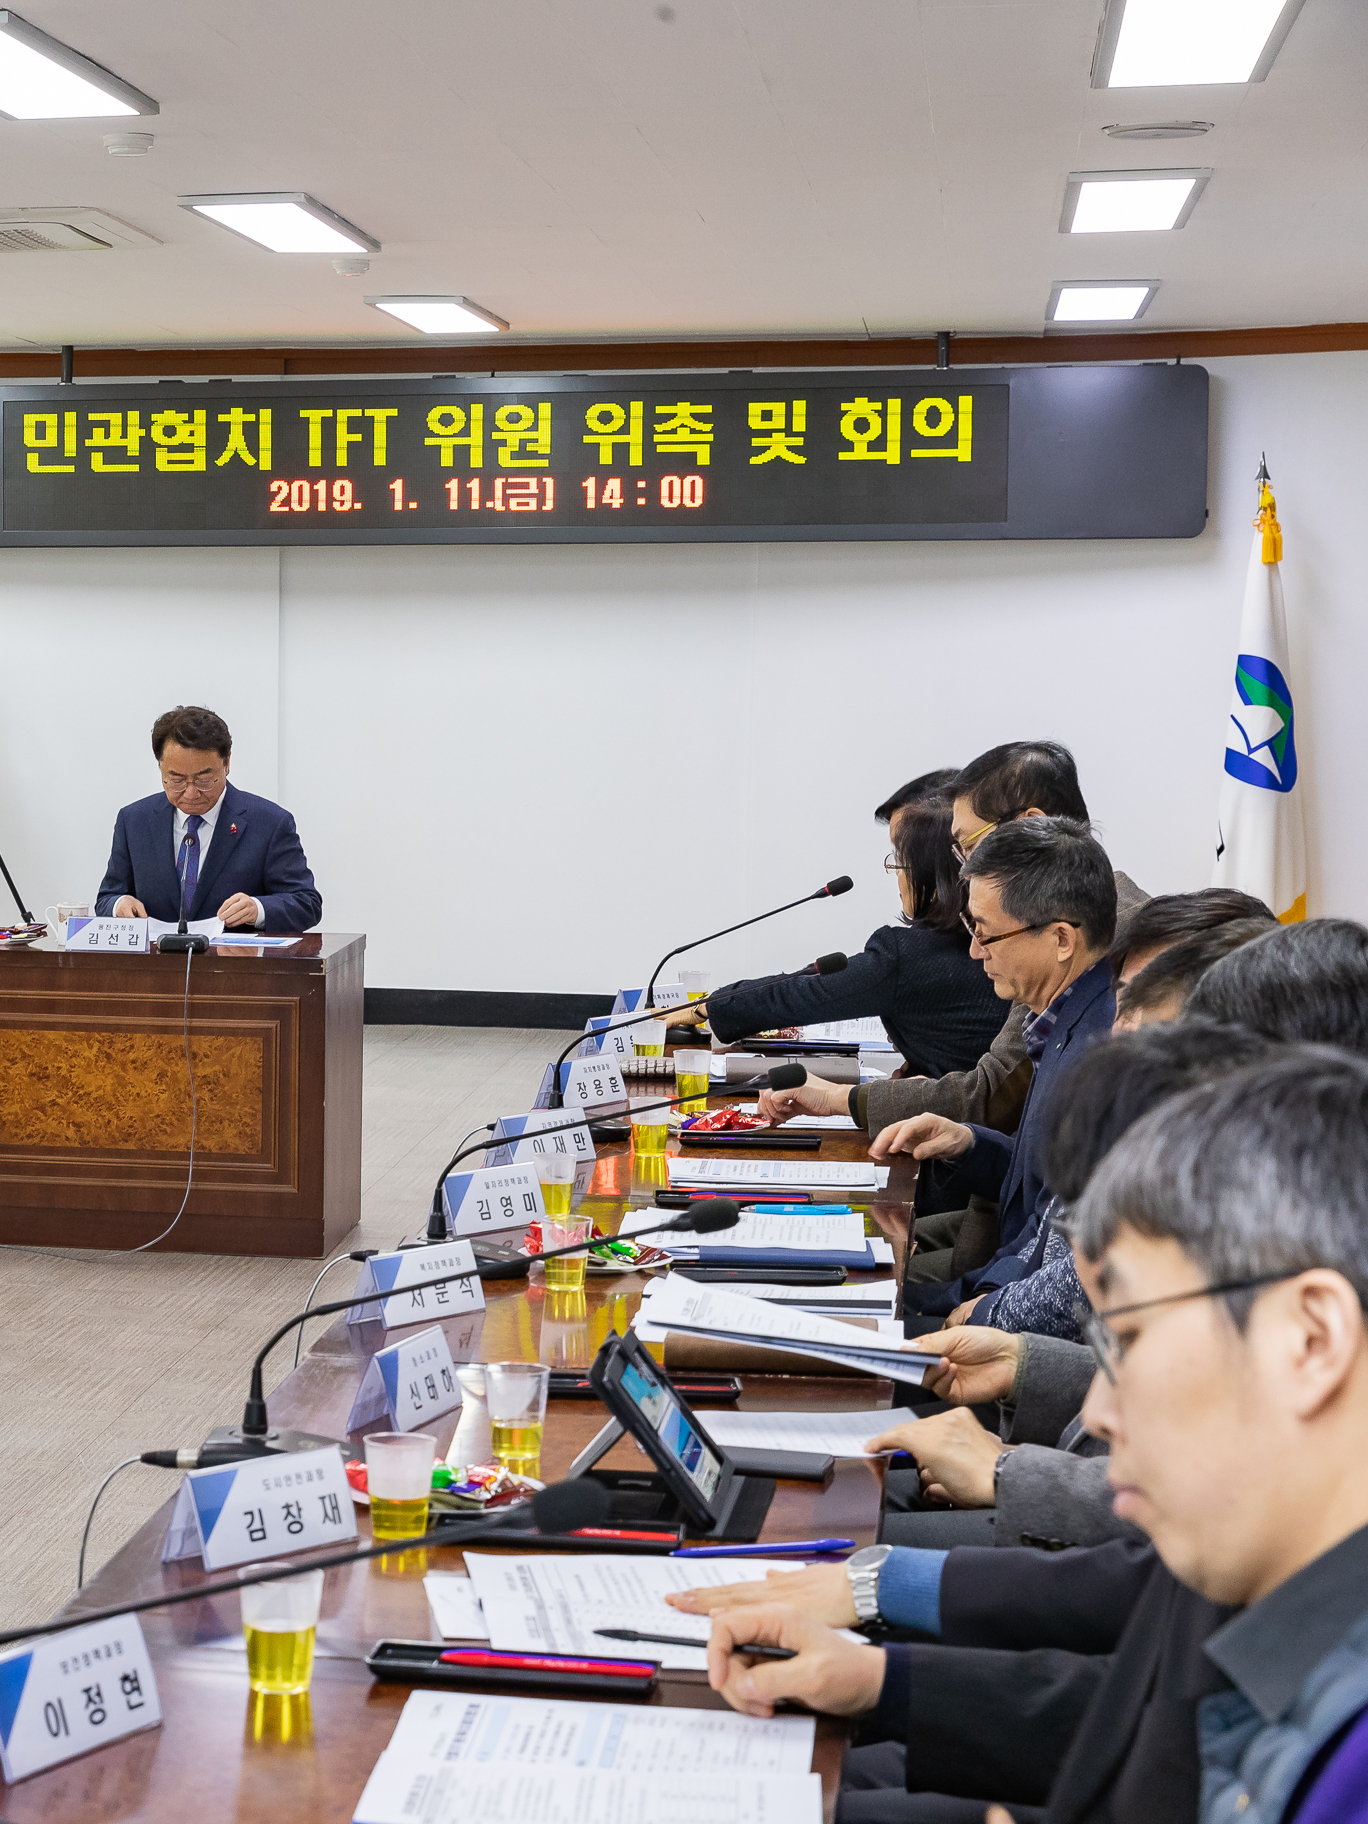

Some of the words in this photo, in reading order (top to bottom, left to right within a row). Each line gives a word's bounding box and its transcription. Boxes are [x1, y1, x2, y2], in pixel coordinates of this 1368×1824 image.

[23, 407, 272, 473] 민관협치
[300, 408, 398, 467] TFT
[424, 402, 552, 468] 위원
[583, 400, 714, 466] 위촉
[747, 399, 807, 465] 및
[838, 395, 973, 464] 회의
[269, 479, 363, 512] 2019.
[389, 477, 418, 511] 1.
